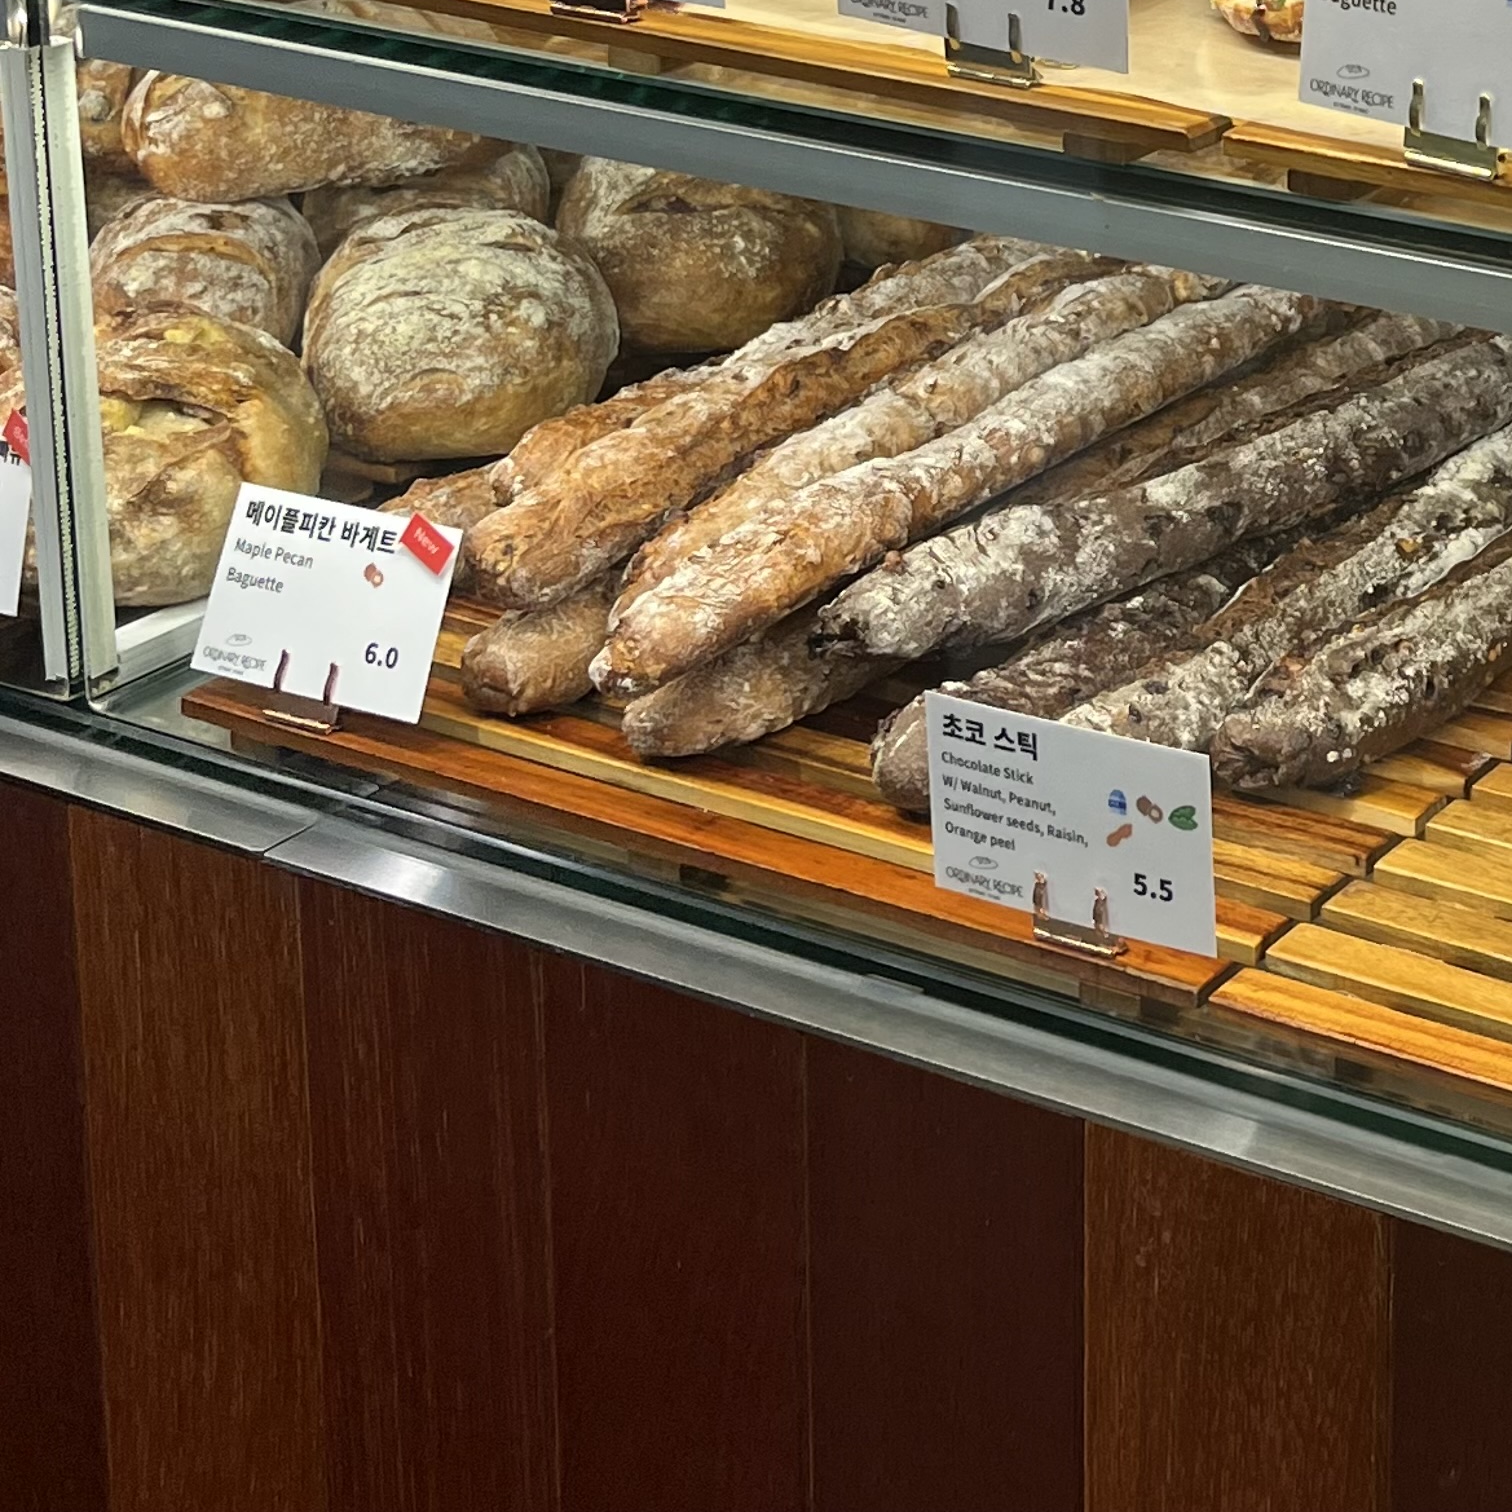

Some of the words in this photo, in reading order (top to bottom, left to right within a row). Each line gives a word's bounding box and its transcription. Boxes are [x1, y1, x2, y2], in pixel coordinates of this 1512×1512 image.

[246, 500, 336, 542] 메이플피칸
[341, 521, 398, 554] 바게트
[413, 527, 439, 555] New
[234, 538, 272, 559] Maple
[275, 546, 313, 569] Pecan
[226, 567, 284, 593] Baguette
[365, 642, 398, 669] 6.0
[942, 714, 986, 746] 초코
[994, 728, 1038, 761] 스틱
[941, 750, 1000, 777] Chocolate
[1004, 768, 1034, 785] Stick
[960, 778, 1006, 804] Walnut,
[1009, 791, 1056, 816] Peanut,
[944, 798, 1003, 824] Sunflower
[1006, 815, 1044, 837] seeds,
[1048, 824, 1088, 848] Raisin,
[945, 822, 987, 845] Orange
[990, 836, 1016, 851] peel
[1133, 872, 1173, 902] 5.5
